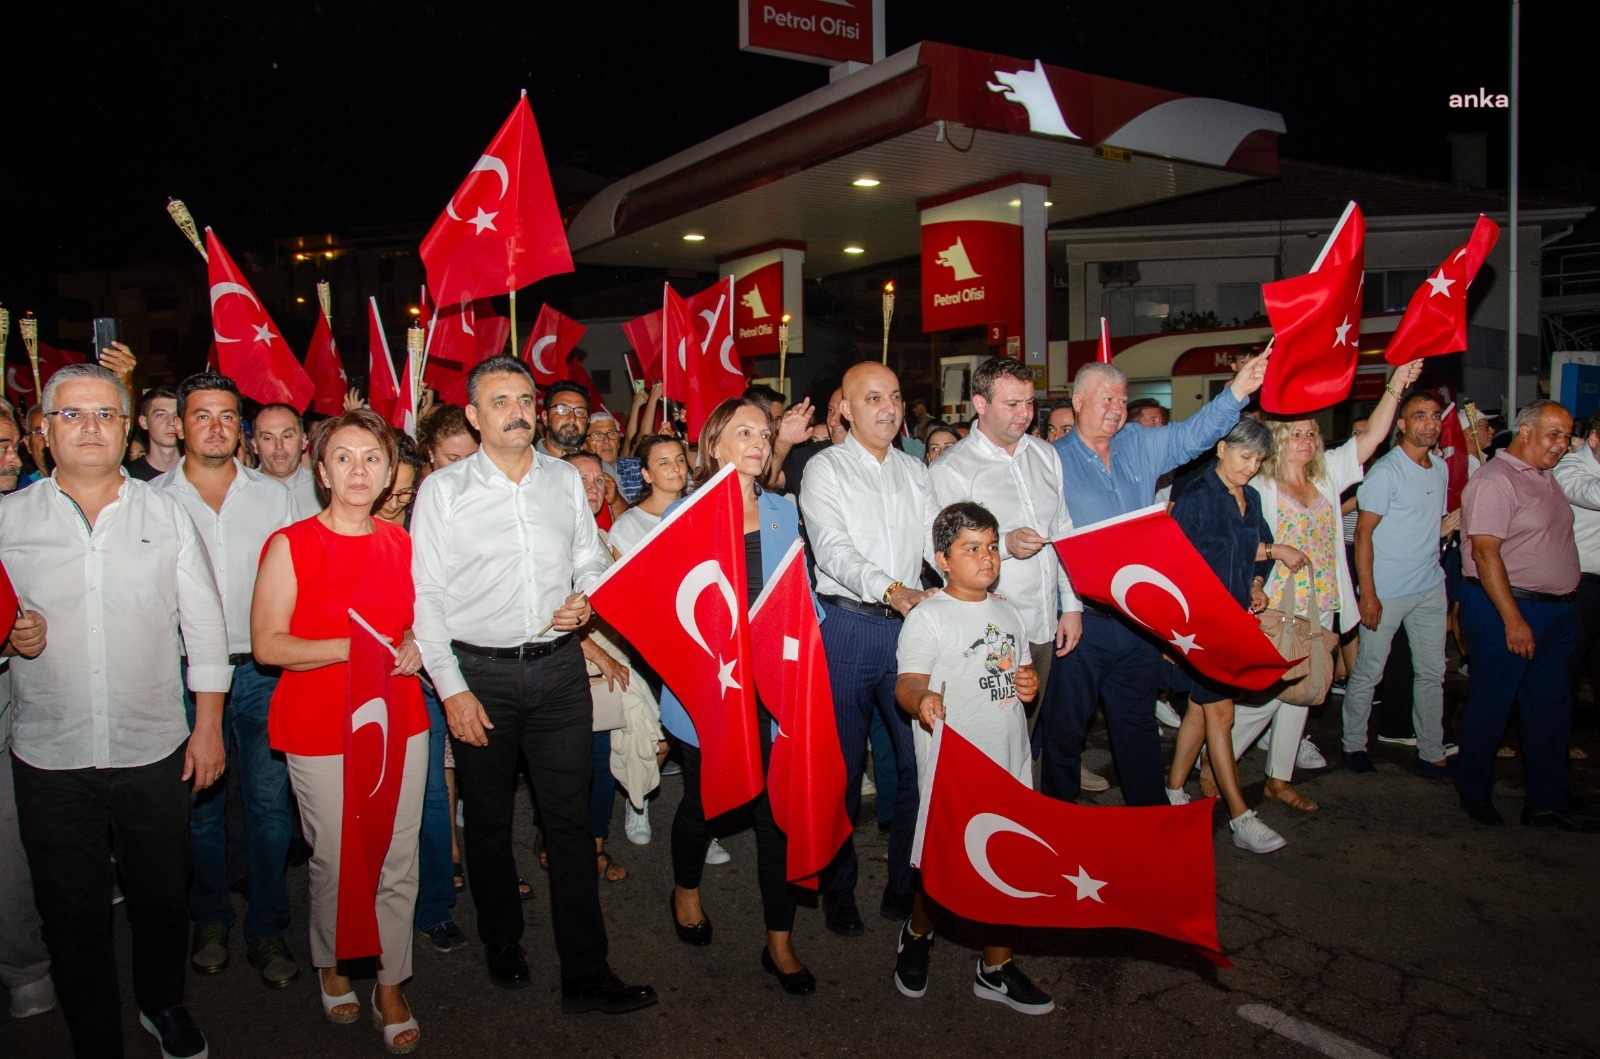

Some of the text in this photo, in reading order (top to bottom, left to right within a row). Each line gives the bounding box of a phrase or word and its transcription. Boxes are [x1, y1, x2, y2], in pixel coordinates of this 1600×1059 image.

[763, 5, 860, 39] Petrol Ofisi
[934, 286, 985, 307] Petrol Ofisi
[740, 323, 773, 339] Petrol Ofisi
[992, 327, 1000, 339] 3
[979, 671, 1015, 690] GET NE
[991, 686, 1016, 702] RULE
